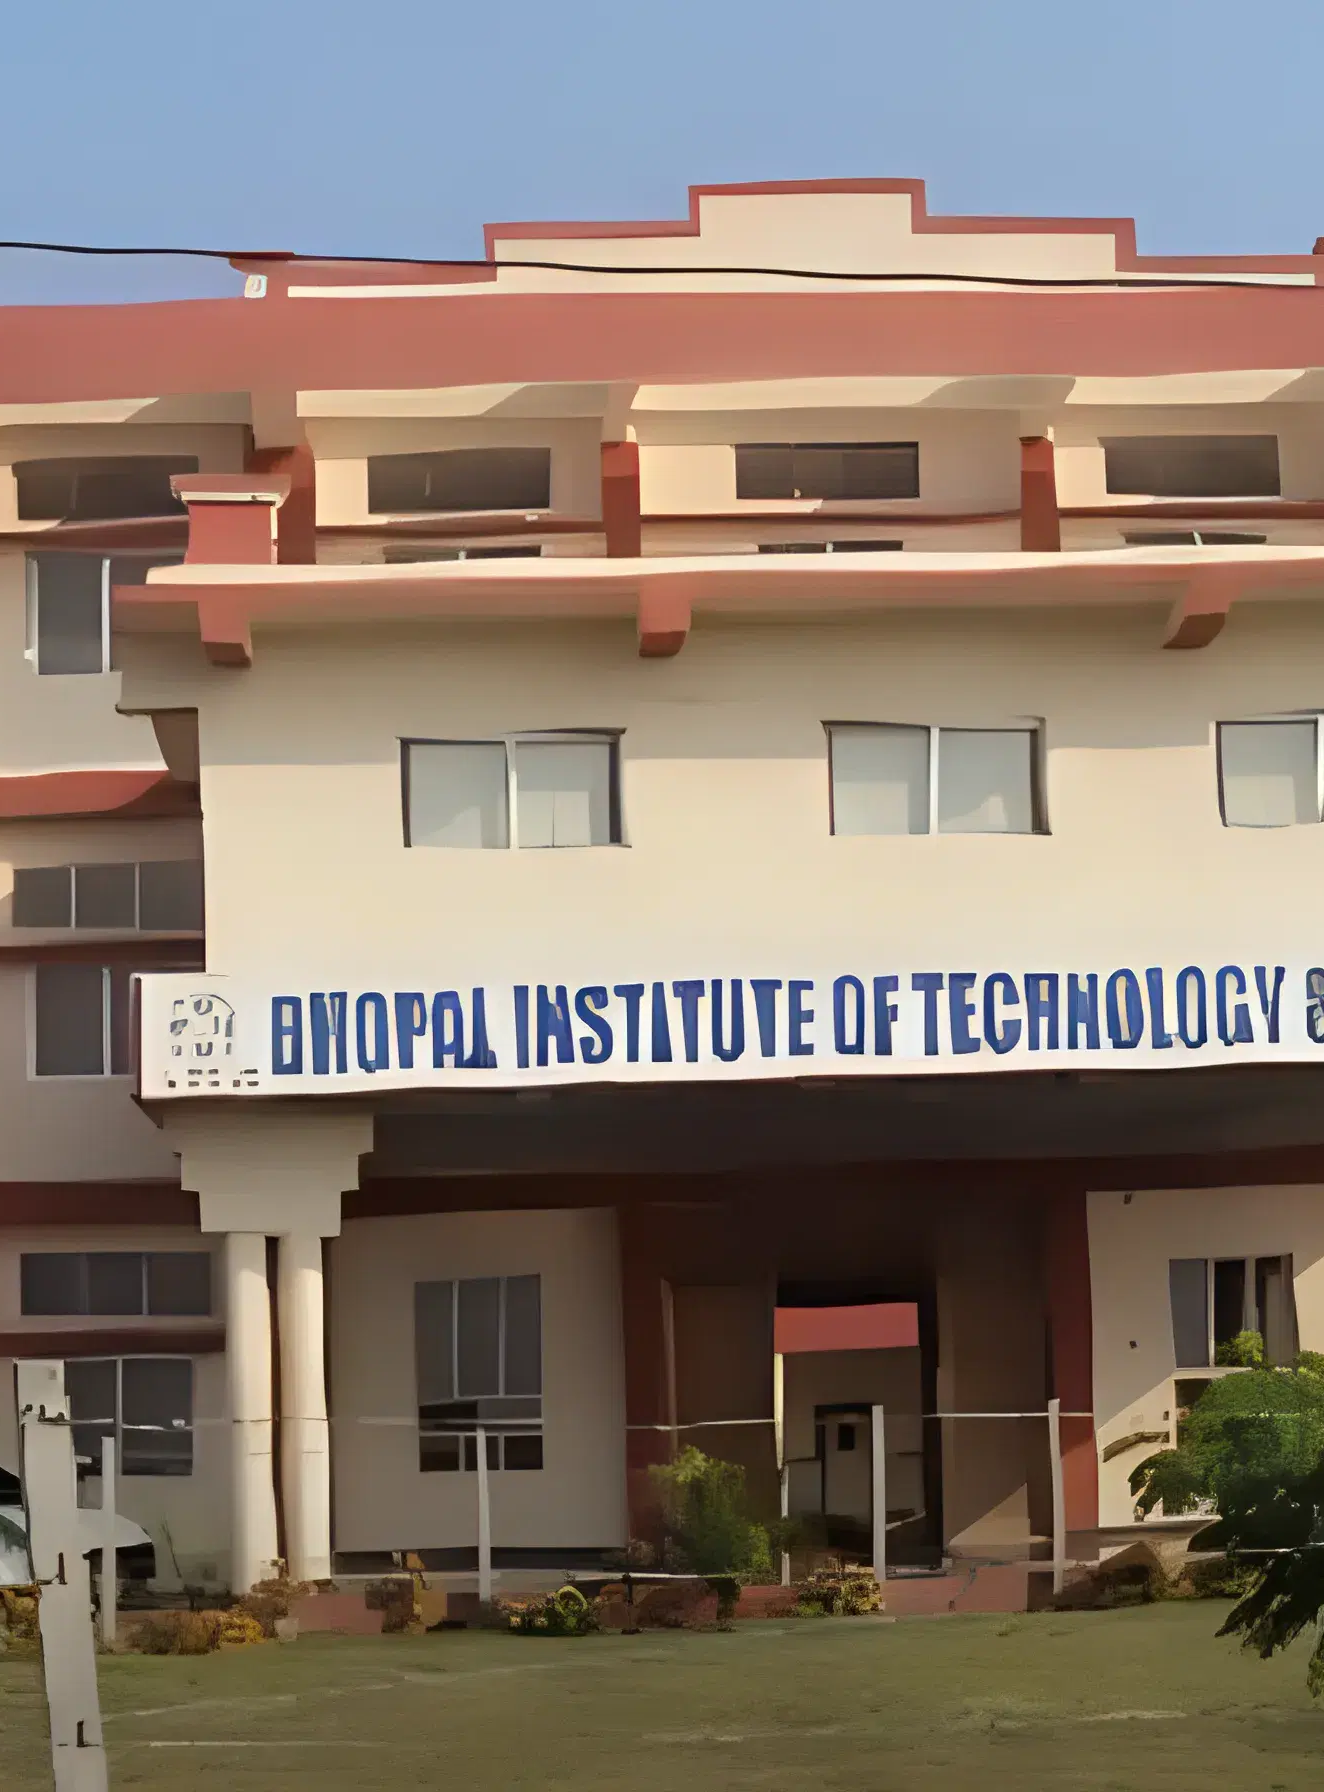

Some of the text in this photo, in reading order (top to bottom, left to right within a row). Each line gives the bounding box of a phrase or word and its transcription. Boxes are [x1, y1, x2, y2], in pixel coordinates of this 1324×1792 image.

[513, 978, 815, 1069] INSTITUTE
[832, 974, 899, 1056] OF
[911, 965, 1286, 1056] TECHNOLOGY
